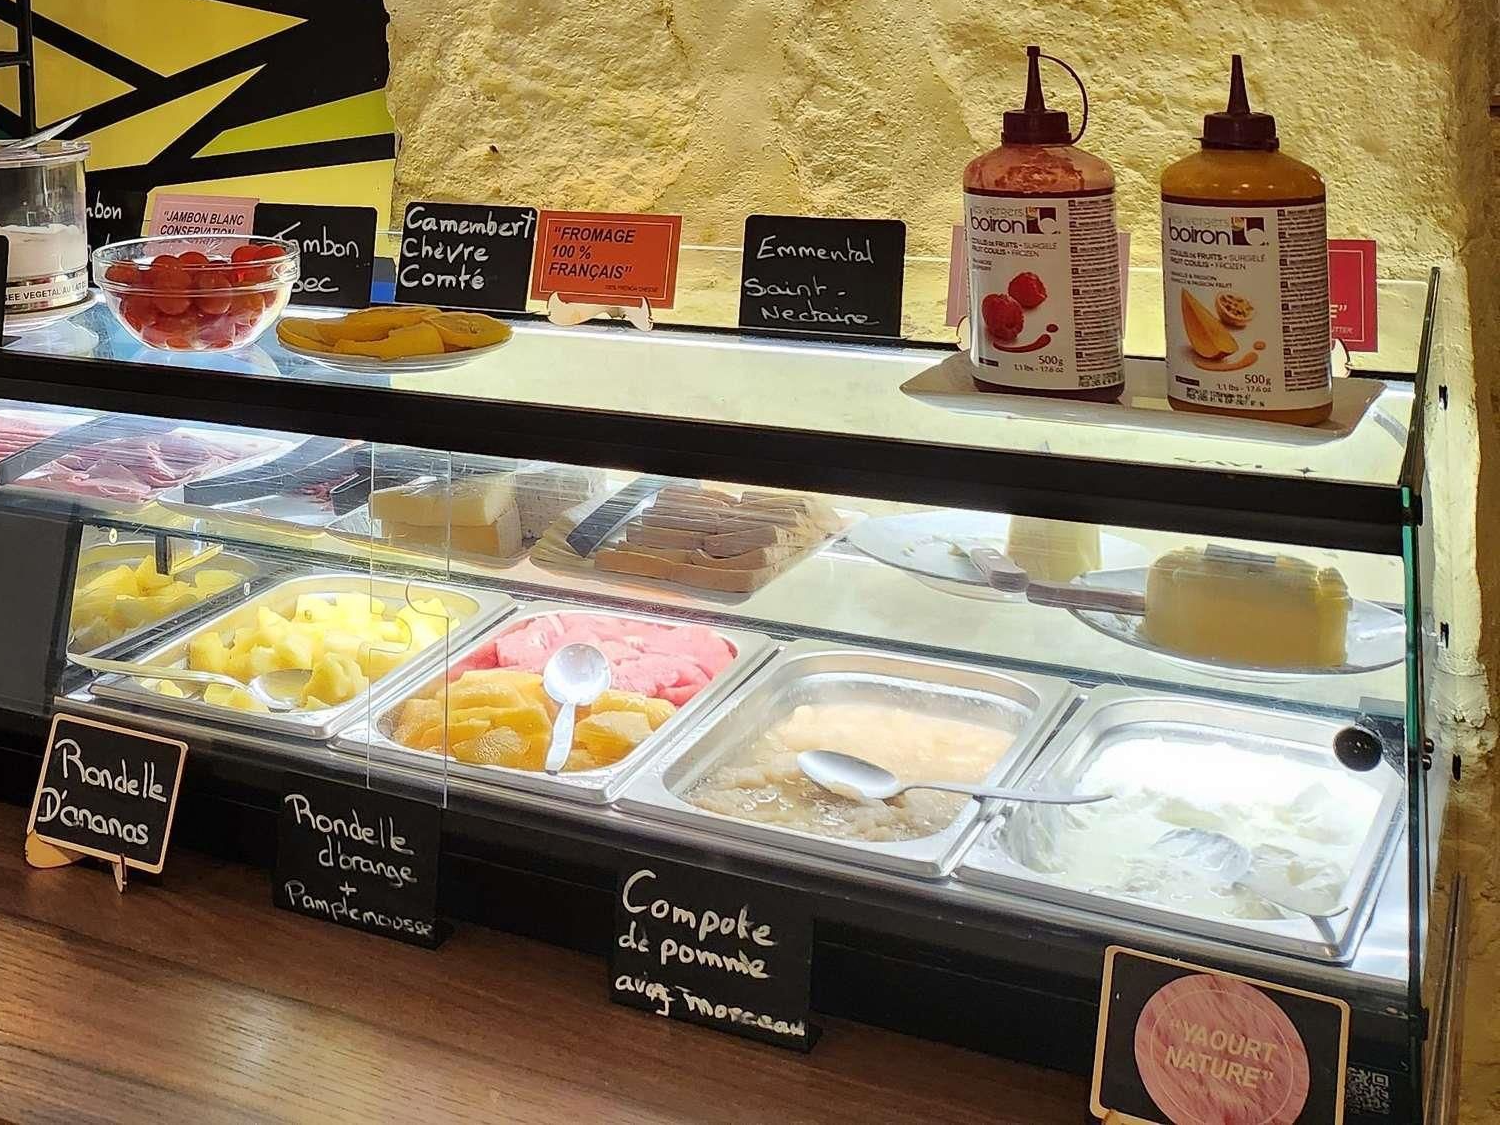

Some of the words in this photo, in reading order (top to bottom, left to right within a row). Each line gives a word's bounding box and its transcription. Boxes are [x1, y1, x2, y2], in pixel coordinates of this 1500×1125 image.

[164, 210, 208, 224] "JAMBON
[209, 213, 245, 226] BLANC
[406, 206, 536, 239] Camembert
[970, 208, 1026, 234] boiron
[1168, 217, 1231, 245] boiron
[402, 234, 490, 264] Chèvre
[553, 226, 637, 245] "FROMAGE
[756, 234, 875, 264] Emmental
[551, 245, 575, 259] 100
[579, 245, 592, 260] %
[400, 264, 486, 291] Comté
[549, 262, 633, 282] FRANÇAIS"
[23, 288, 61, 300] VEGETAL
[761, 299, 880, 325] Nectaire
[55, 738, 167, 803] Rondelle
[37, 786, 149, 845] D'ananas
[284, 793, 415, 856] Rondelle
[318, 834, 417, 888] d'orange
[622, 869, 778, 947] Compote
[618, 920, 649, 952] de
[660, 938, 771, 979] pomme
[1169, 1018, 1278, 1063] "YAOURT
[1164, 1045, 1274, 1090] NATURE"
